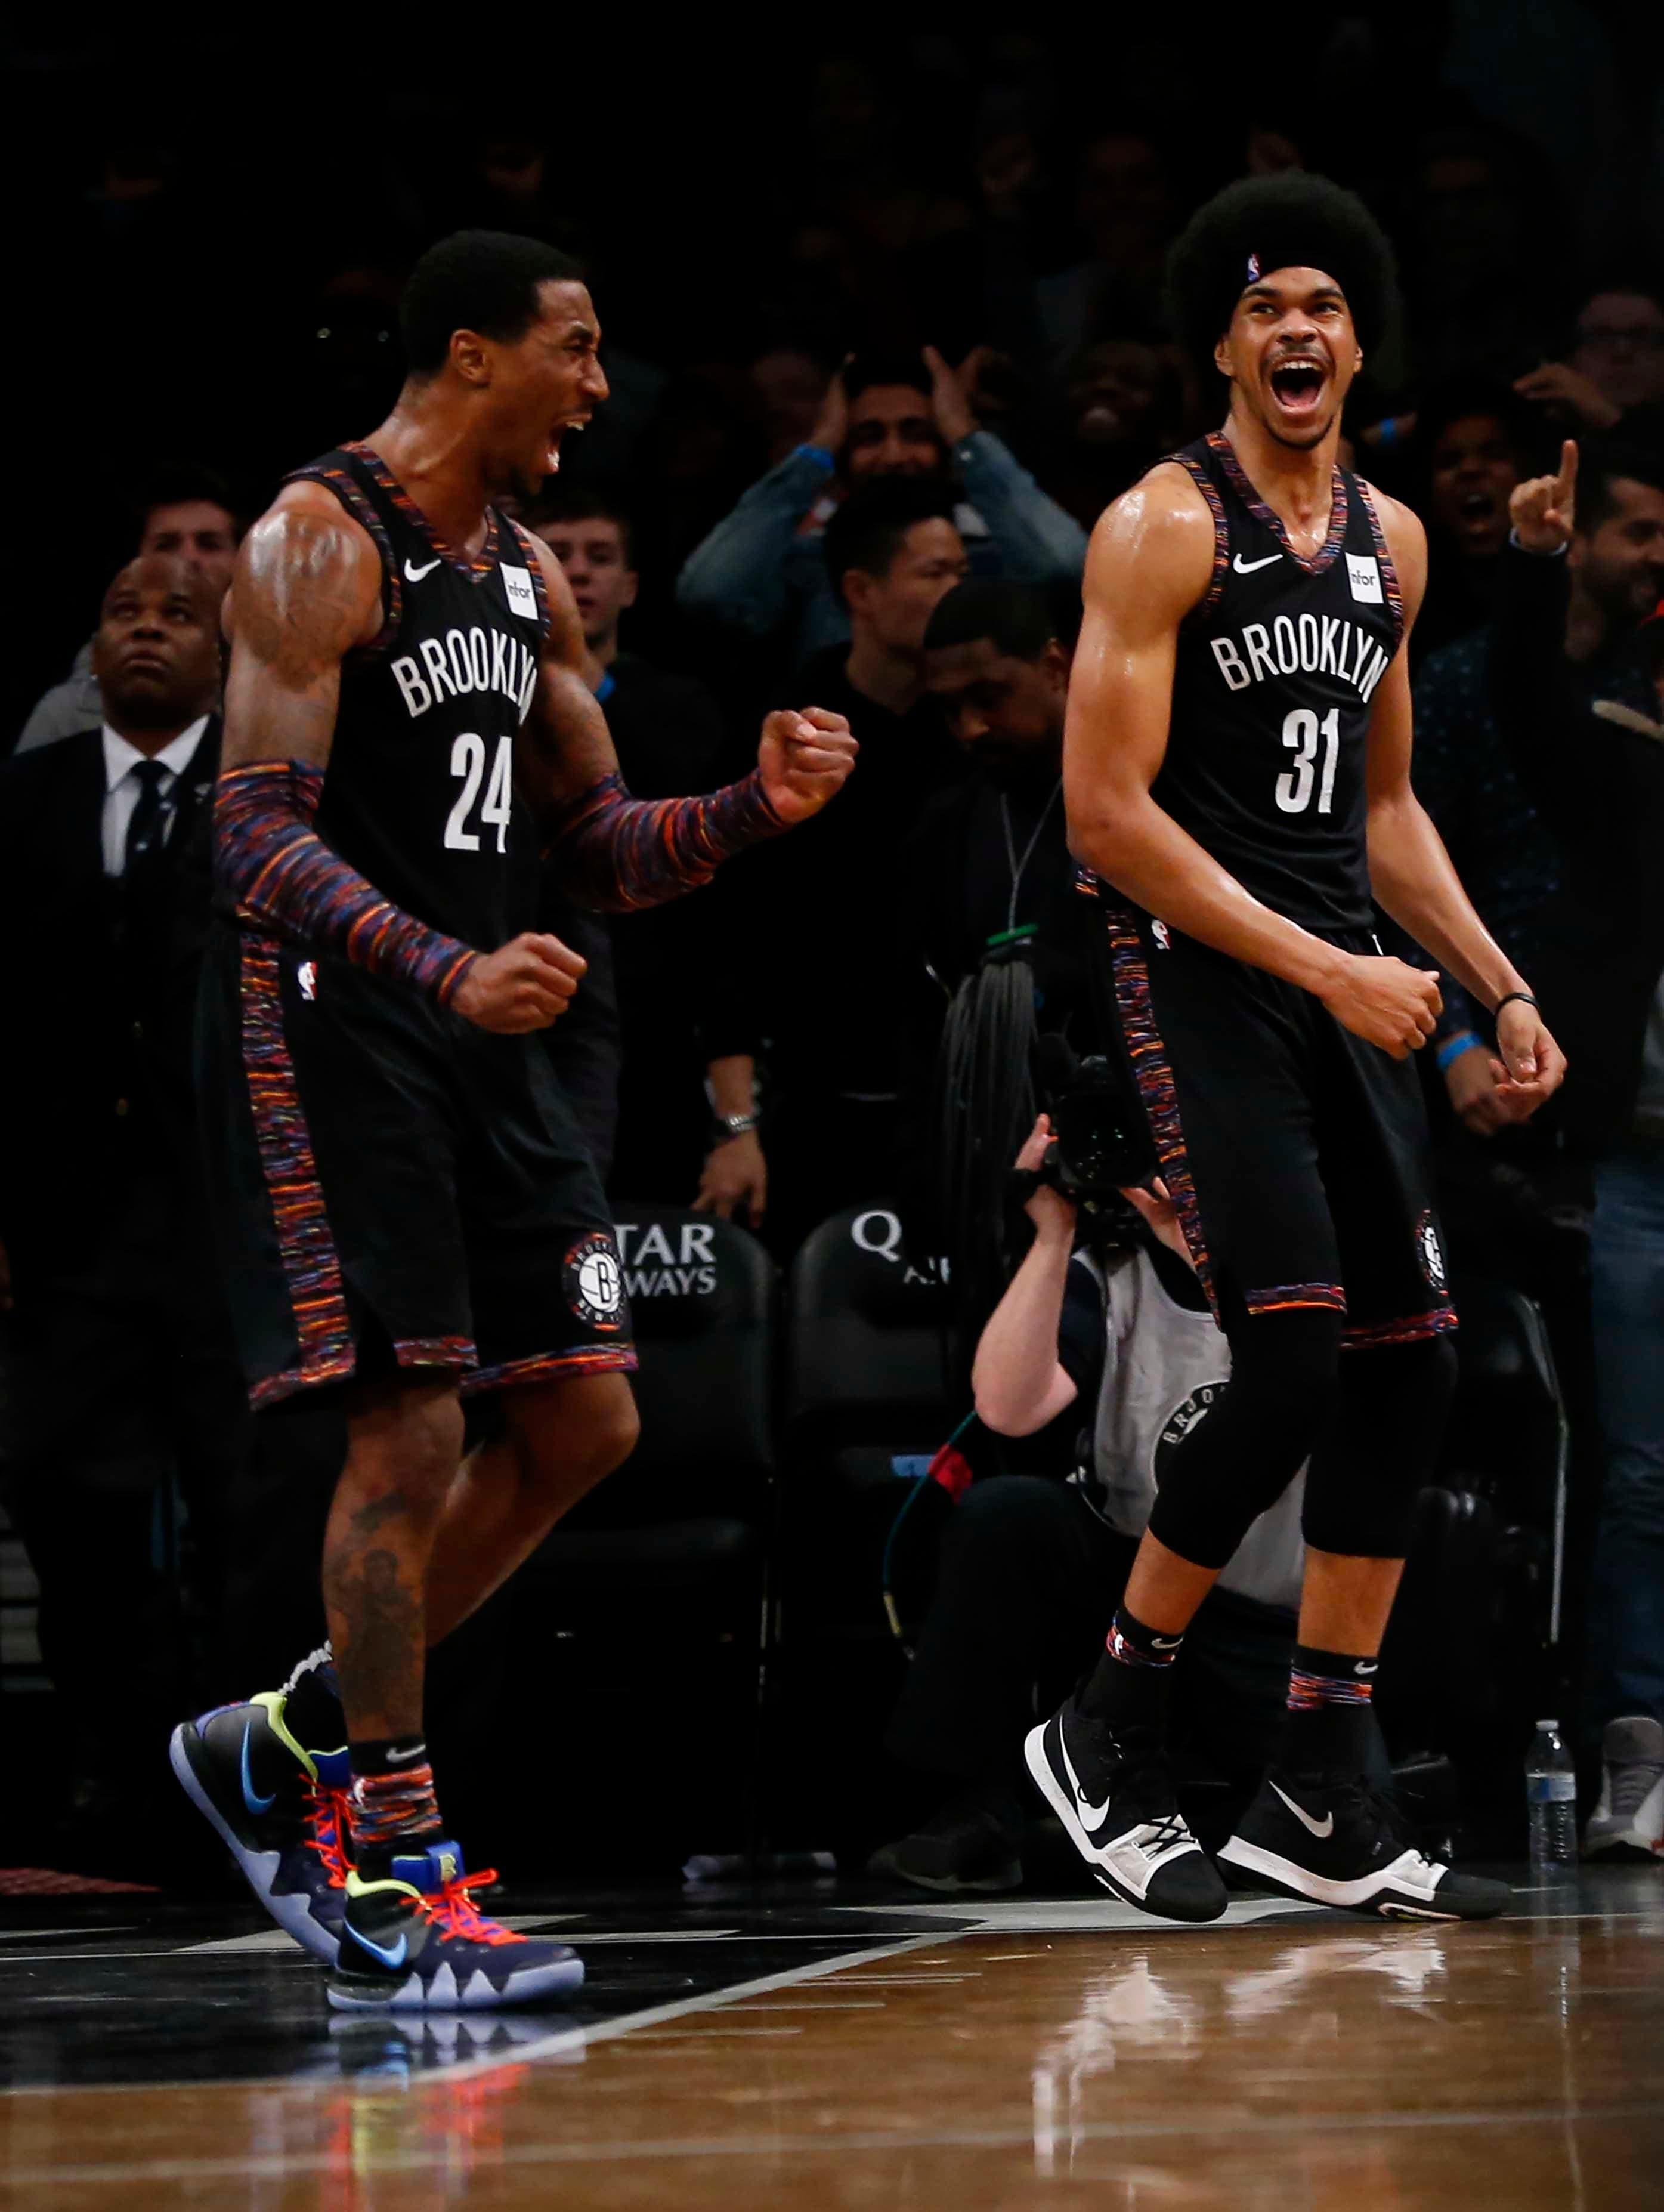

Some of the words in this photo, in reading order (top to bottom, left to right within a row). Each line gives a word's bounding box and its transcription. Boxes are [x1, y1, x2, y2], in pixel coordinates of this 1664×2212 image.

[1210, 613, 1390, 705] BROOKLYN
[444, 732, 513, 854] 24
[1275, 708, 1340, 815] 31
